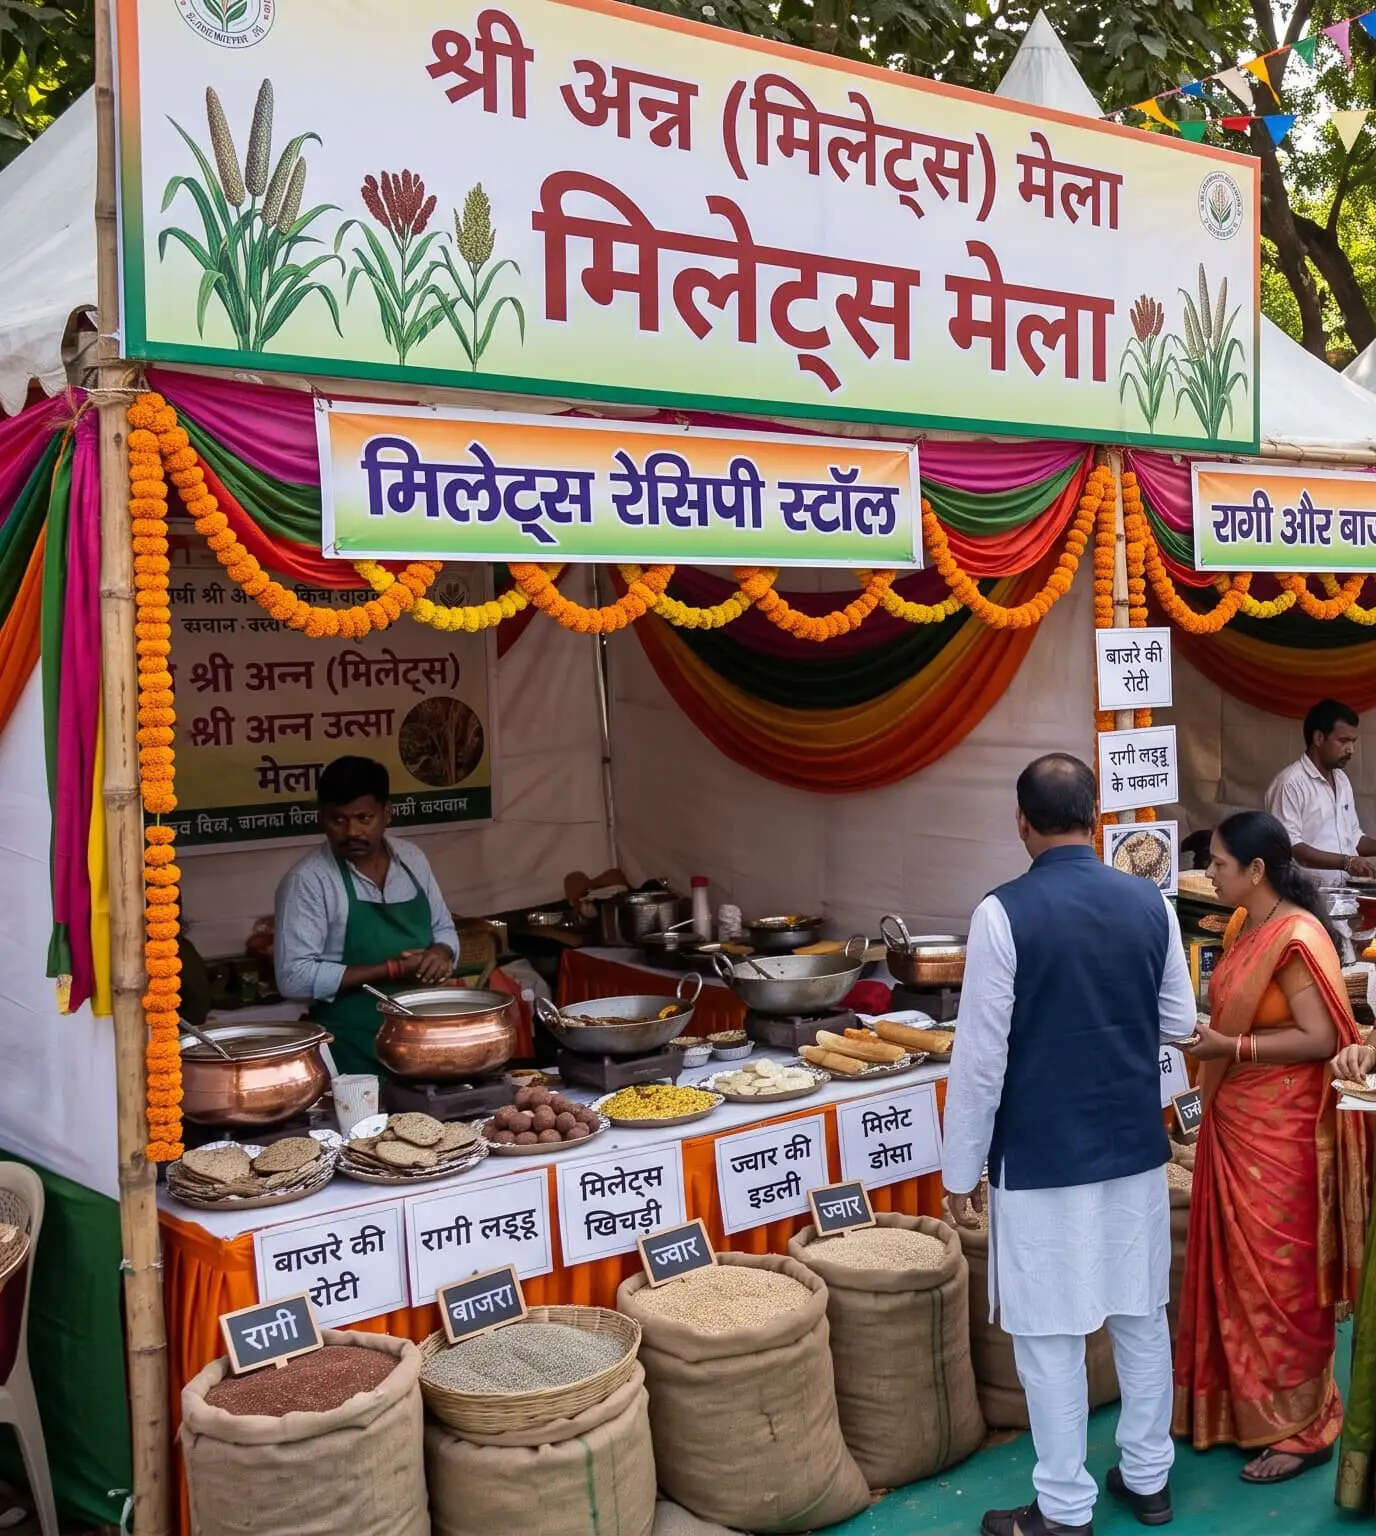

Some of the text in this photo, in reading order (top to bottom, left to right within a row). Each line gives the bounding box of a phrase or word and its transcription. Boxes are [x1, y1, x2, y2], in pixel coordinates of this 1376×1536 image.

[425, 9, 534, 119] श्री
[560, 59, 699, 151] अन्न
[722, 73, 997, 222] (मिलेट्स)
[1016, 131, 1123, 230] मेला
[531, 170, 1115, 392] मिलेट्स मेला
[361, 437, 899, 543] मिलेट्स रेसिपी स्टॉल
[1211, 490, 1273, 543] रागी
[1281, 491, 1332, 544] और
[189, 653, 234, 694] श्री
[245, 659, 315, 692] अन्न
[326, 648, 461, 696] (मिलेट्स)
[1105, 641, 1163, 665] बाजरे की
[1123, 669, 1150, 693] रोटी
[245, 712, 314, 745] अन्न
[1109, 743, 1136, 766] रागी
[254, 755, 324, 794] मेला
[1111, 772, 1169, 793] के पकवान
[861, 1105, 913, 1138] मिलेट
[730, 1133, 812, 1174] ज्वार की
[868, 1141, 913, 1170] डोसा
[579, 1165, 664, 1201] मिलेट्स
[747, 1170, 802, 1209] इडली
[584, 1198, 662, 1240] खिचड़ी
[818, 1195, 863, 1220] ज्वार
[273, 1224, 386, 1273] बाजरे की
[420, 1208, 540, 1251] रागी लड्डू
[651, 1236, 701, 1266] ज्वार
[309, 1271, 360, 1308] रोटी
[449, 1284, 515, 1323] बाजरा
[240, 1308, 300, 1351] रागी
